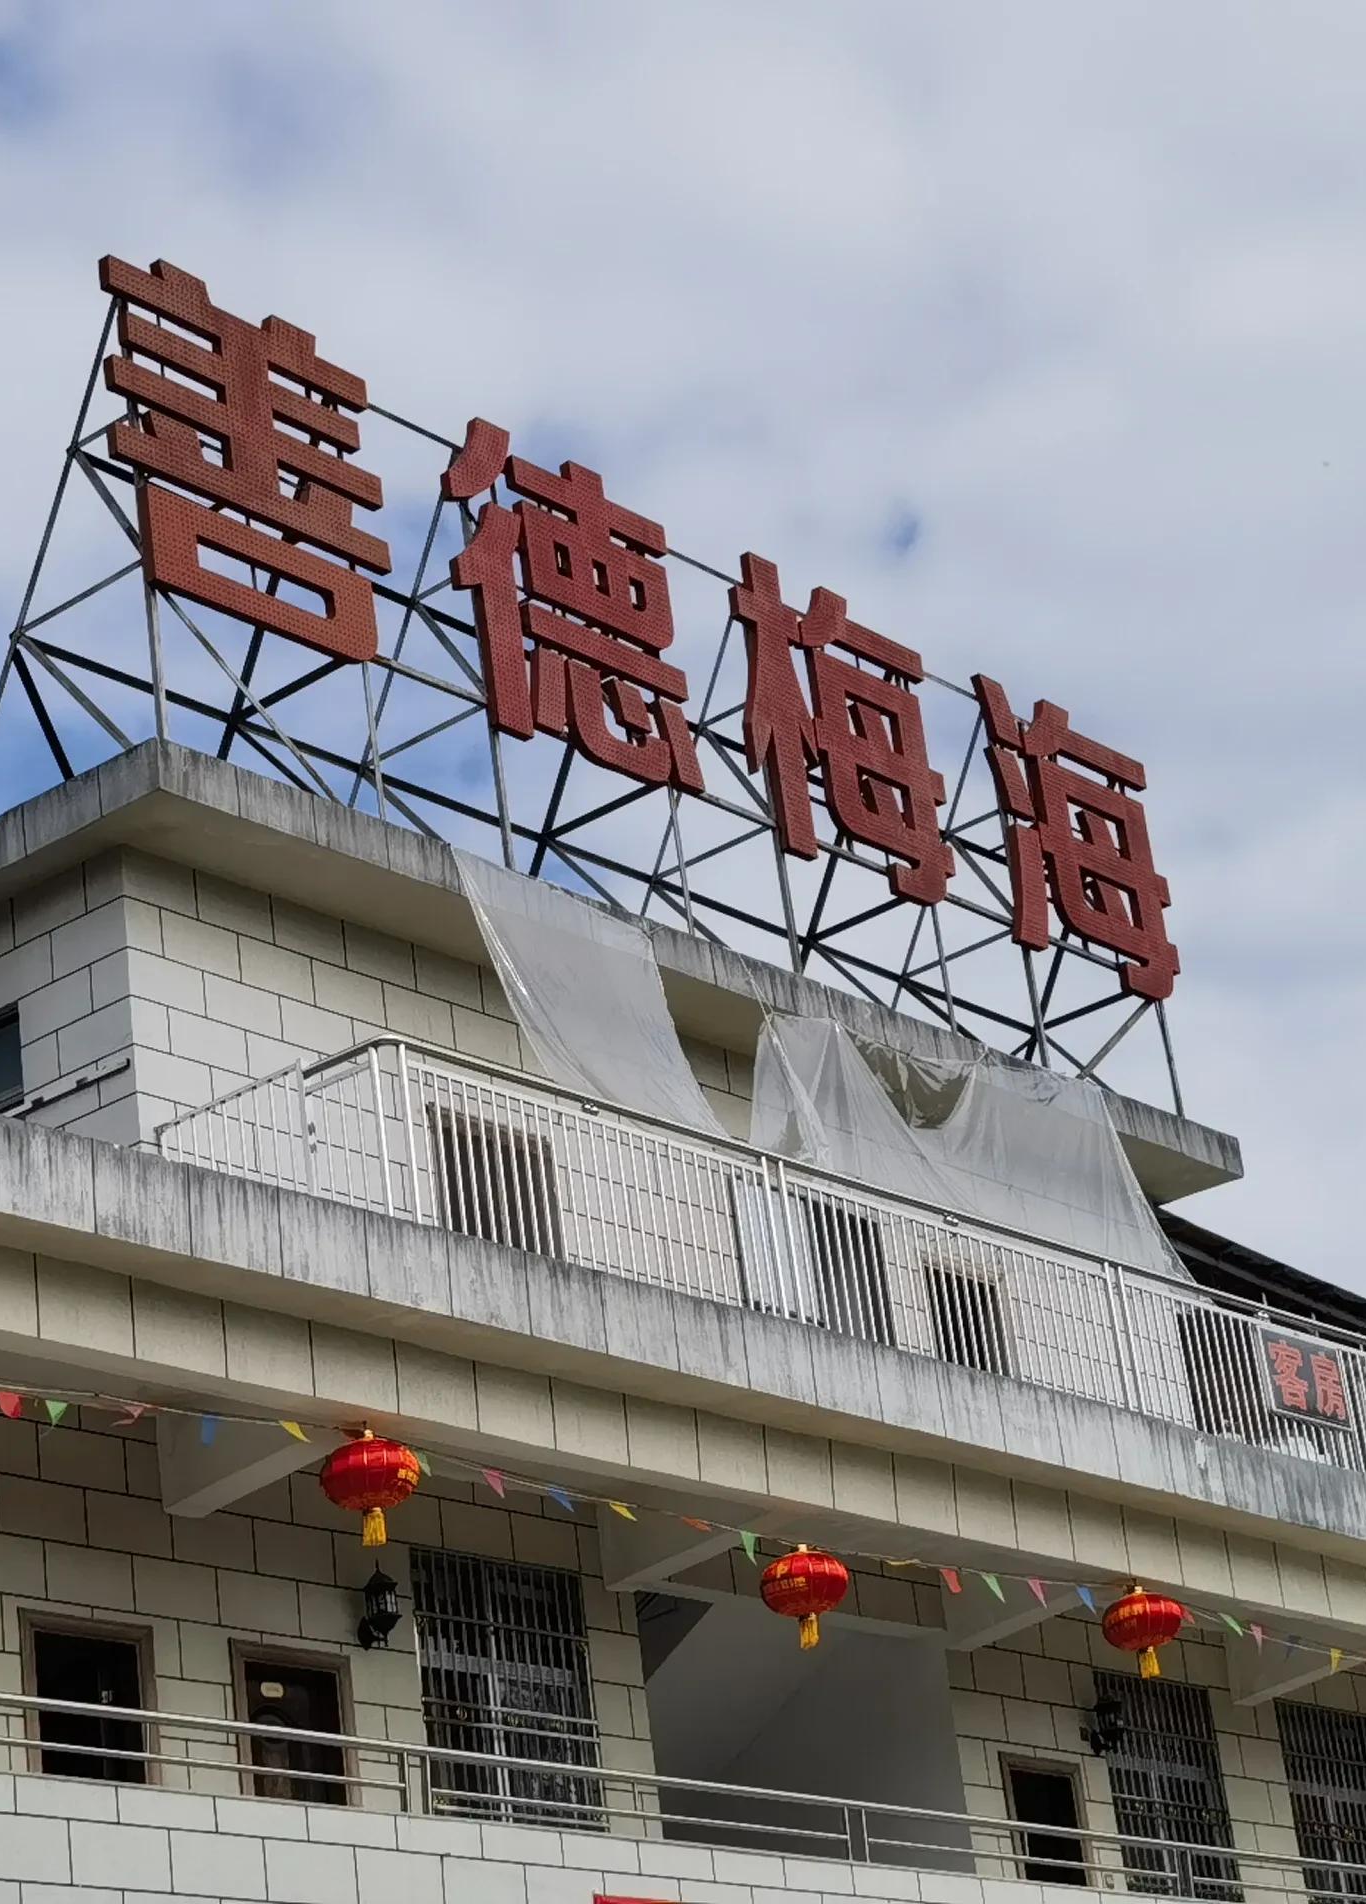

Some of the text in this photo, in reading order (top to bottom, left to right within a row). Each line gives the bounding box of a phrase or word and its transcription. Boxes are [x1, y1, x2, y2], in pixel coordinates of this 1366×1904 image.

[98, 254, 1180, 1000] 善德梅海
[1267, 1339, 1346, 1420] 客房
